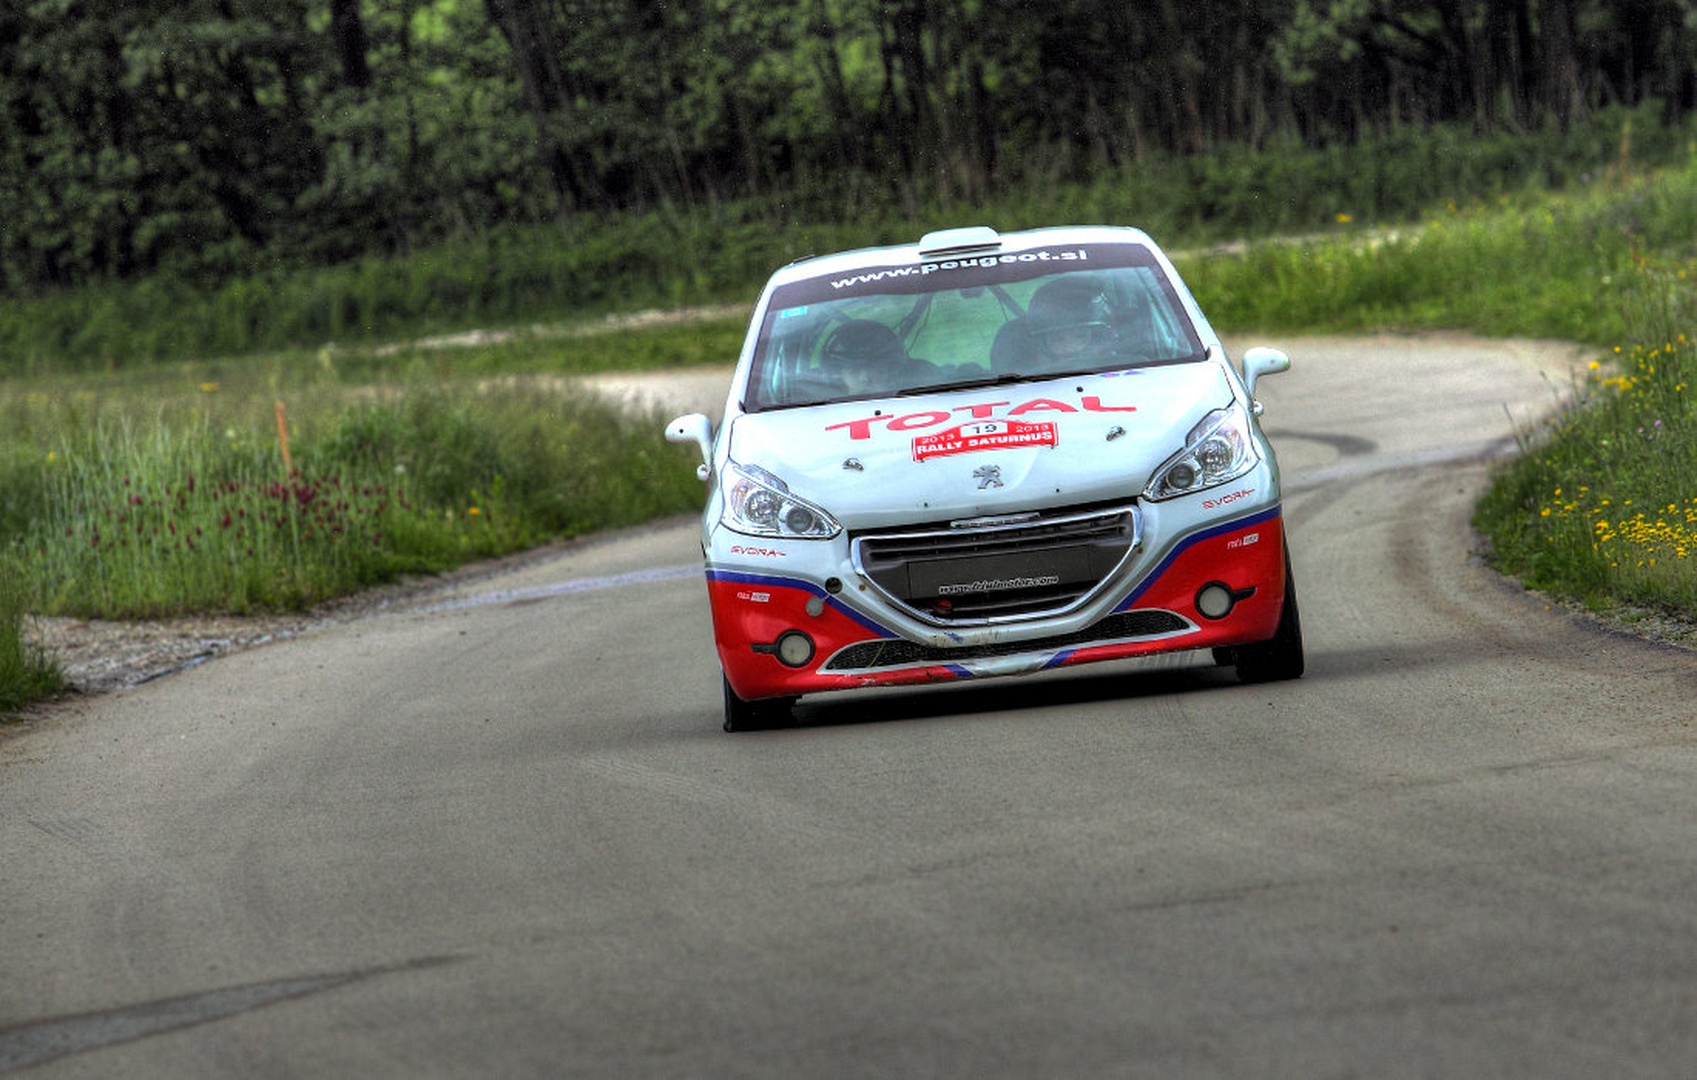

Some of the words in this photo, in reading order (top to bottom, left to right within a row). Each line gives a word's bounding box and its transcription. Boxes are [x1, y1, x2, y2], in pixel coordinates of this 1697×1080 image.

[825, 396, 1137, 440] TOTAL
[972, 423, 998, 434] 19
[1015, 423, 1050, 433] 2013
[916, 440, 963, 454] RALLY
[968, 431, 1052, 447] SATURNUS
[921, 433, 955, 444] 2013
